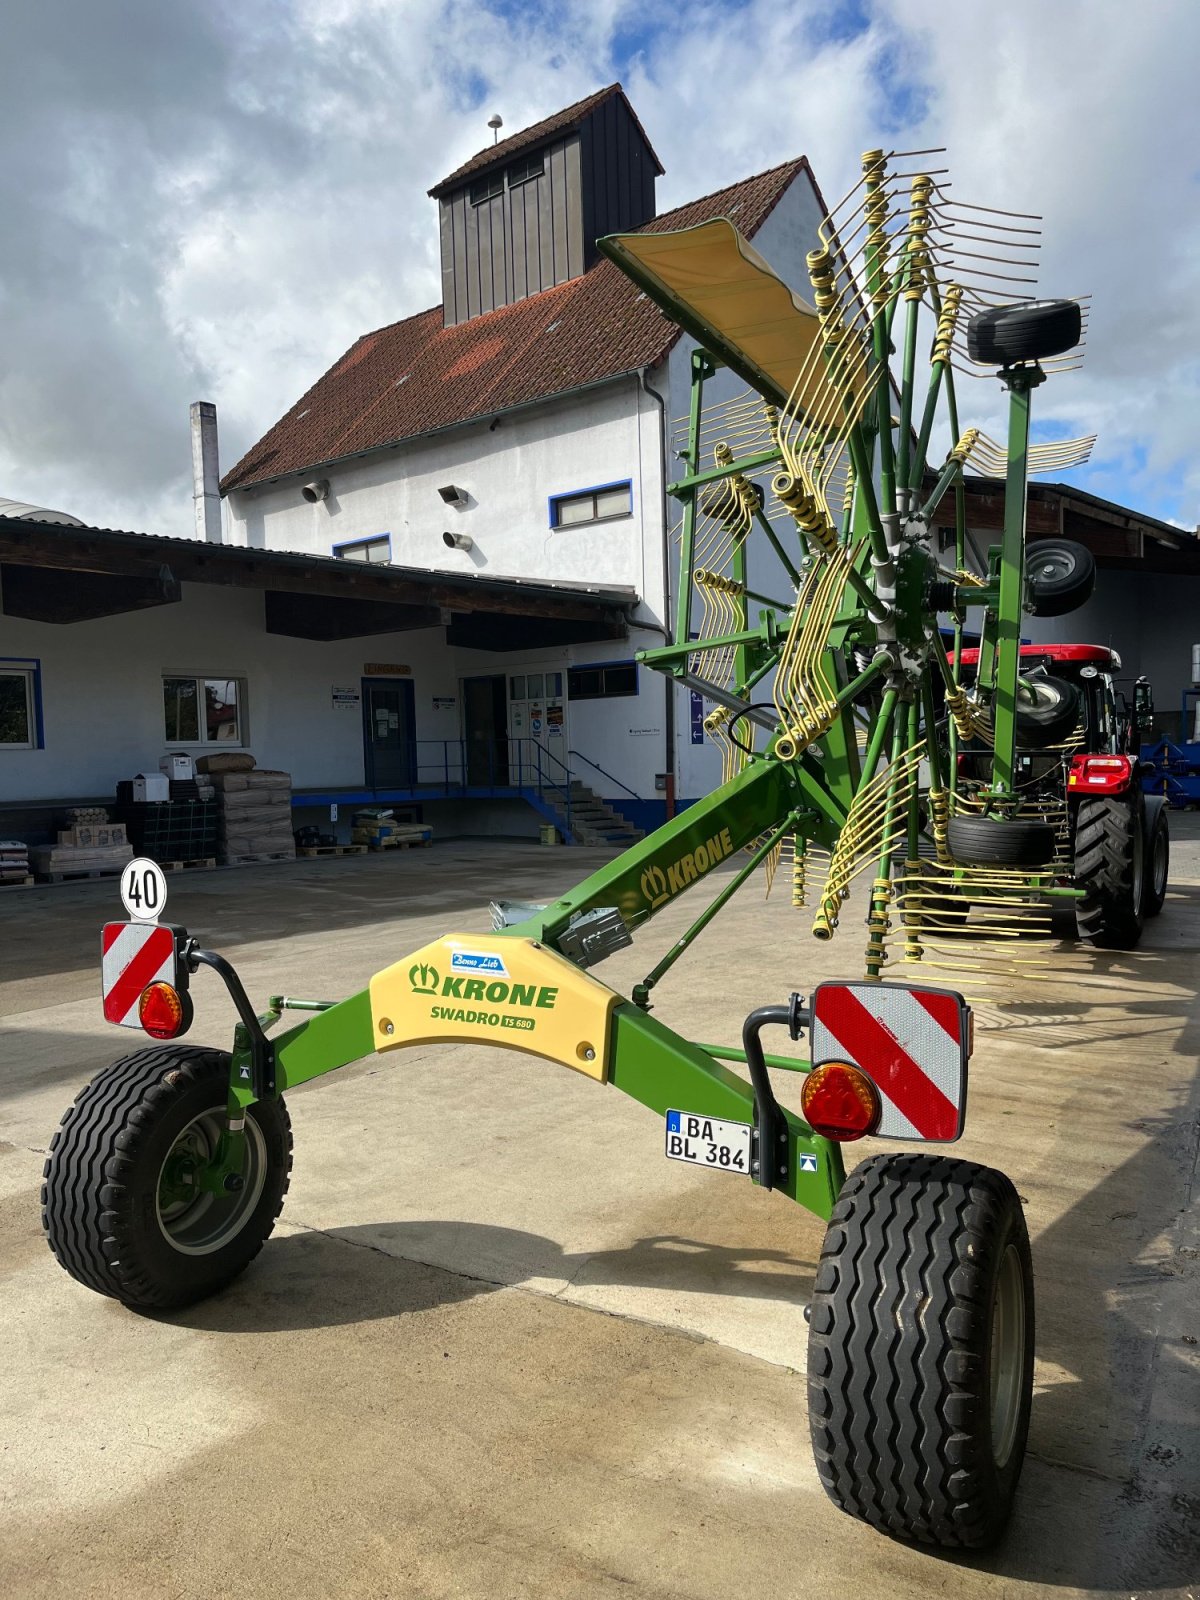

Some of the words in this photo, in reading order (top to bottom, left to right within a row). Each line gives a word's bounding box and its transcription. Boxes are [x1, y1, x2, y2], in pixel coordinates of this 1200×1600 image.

[667, 827, 734, 895] KRONE
[128, 869, 158, 909] 40
[453, 954, 478, 967] Benno
[478, 957, 499, 969] Lieb
[441, 976, 560, 1009] KRONE
[430, 1006, 500, 1027] SWADRO
[504, 1017, 515, 1027] TS
[516, 1019, 532, 1029] 680
[671, 1123, 677, 1132] D
[687, 1117, 714, 1142] BA
[669, 1135, 697, 1160] BL
[705, 1142, 745, 1169] 384
